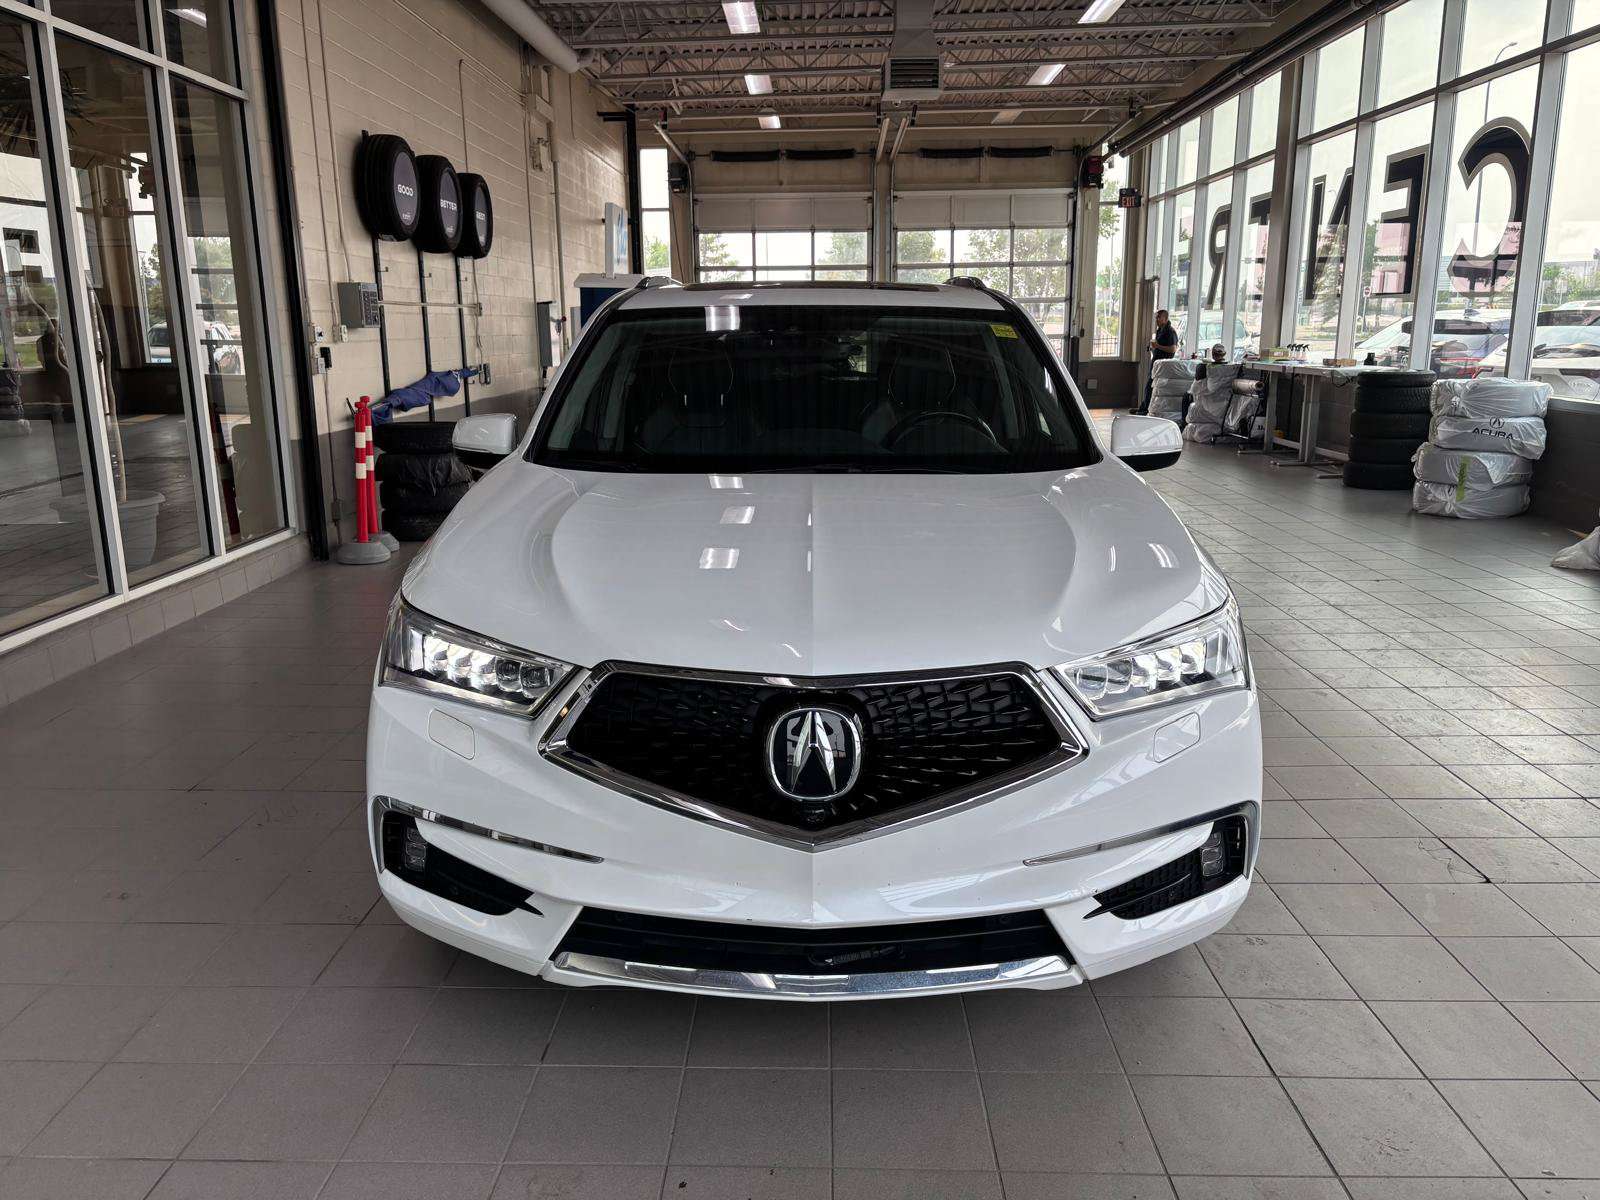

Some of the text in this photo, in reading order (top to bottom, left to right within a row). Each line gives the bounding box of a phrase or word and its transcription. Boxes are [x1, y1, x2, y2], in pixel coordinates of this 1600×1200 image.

[398, 184, 413, 197] GOOD
[440, 199, 457, 211] BETTER
[1121, 196, 1136, 207] EXIT
[1472, 427, 1515, 440] ACURA
